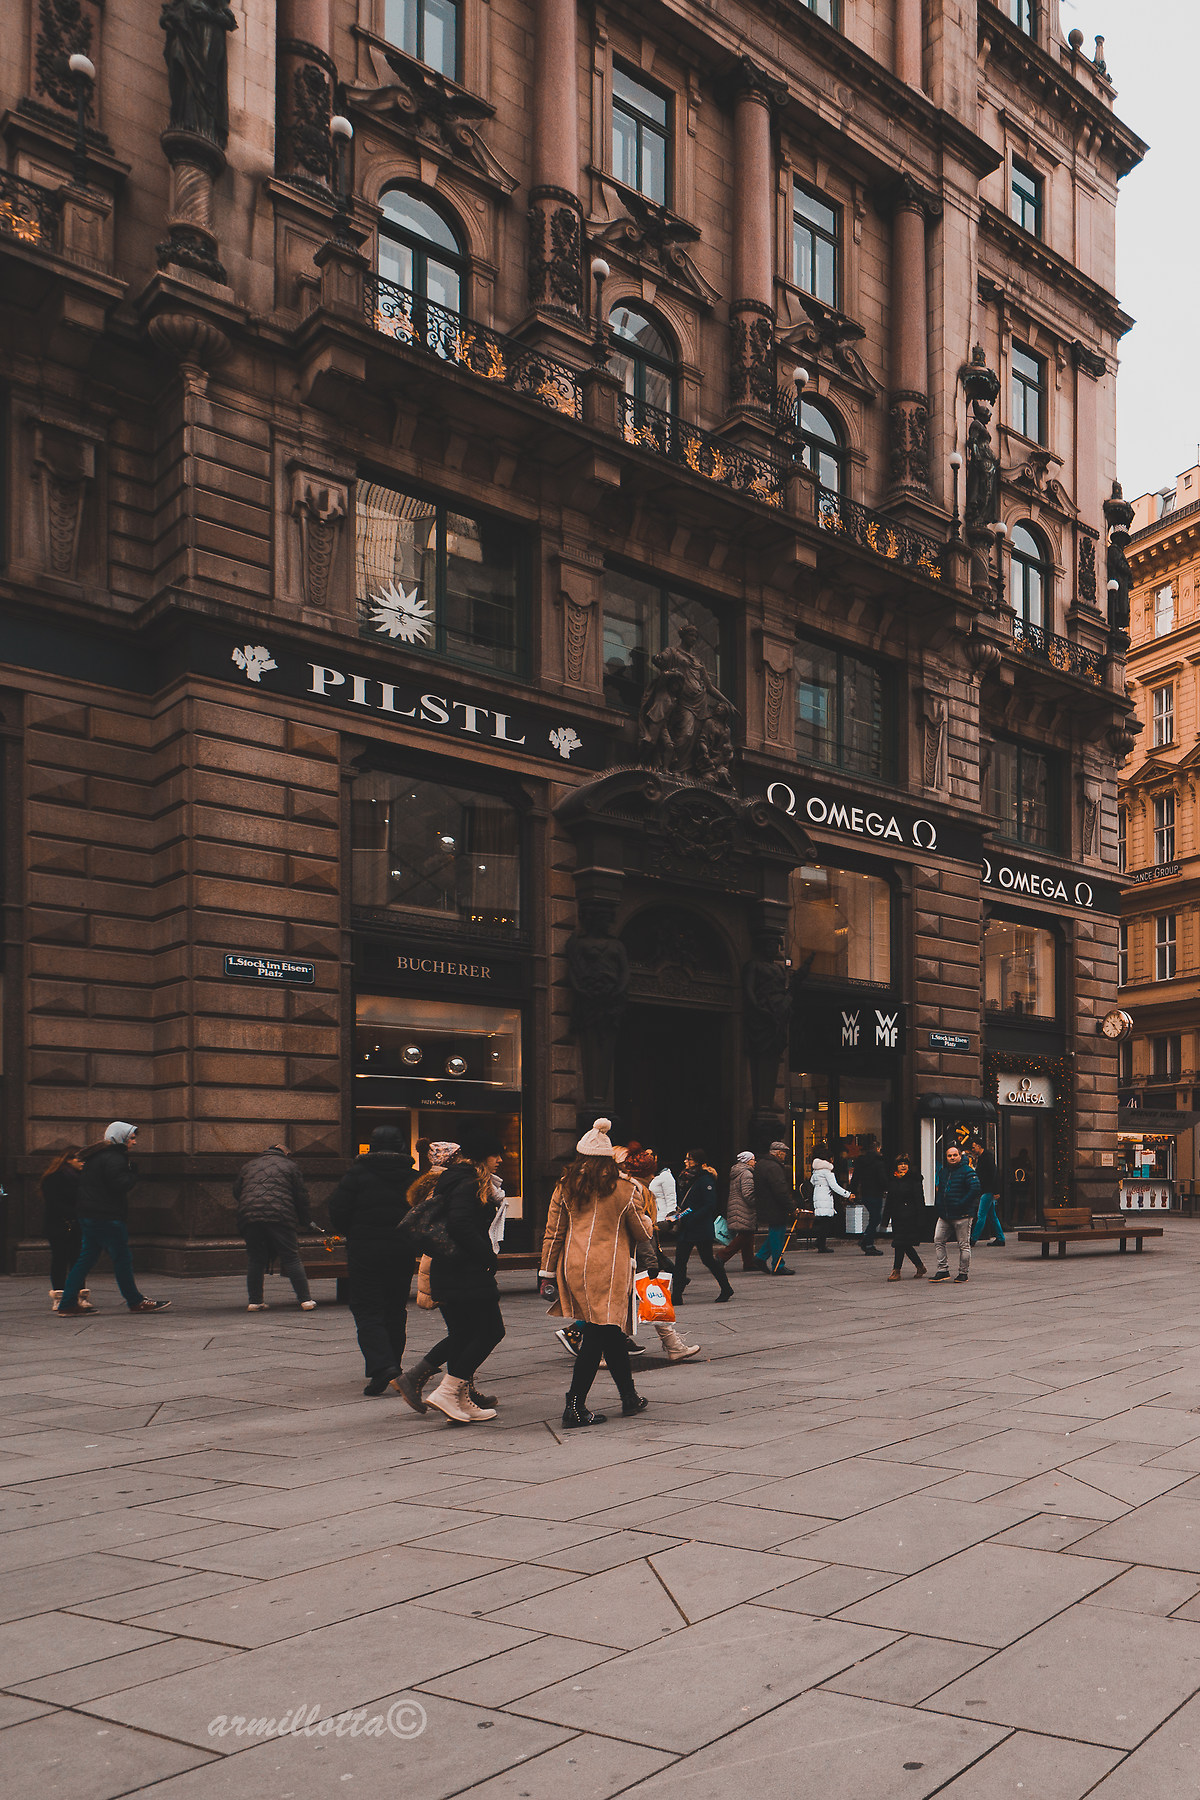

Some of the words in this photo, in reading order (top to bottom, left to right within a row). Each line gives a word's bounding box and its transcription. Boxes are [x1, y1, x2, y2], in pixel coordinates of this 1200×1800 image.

[306, 662, 526, 745] PILSTL
[806, 797, 904, 842] OMEGA
[999, 867, 1069, 902] OMEGA
[258, 968, 284, 978] Platz
[267, 961, 281, 970] im
[397, 956, 491, 979] BUCHERER
[1007, 1091, 1046, 1104] OMEGA
